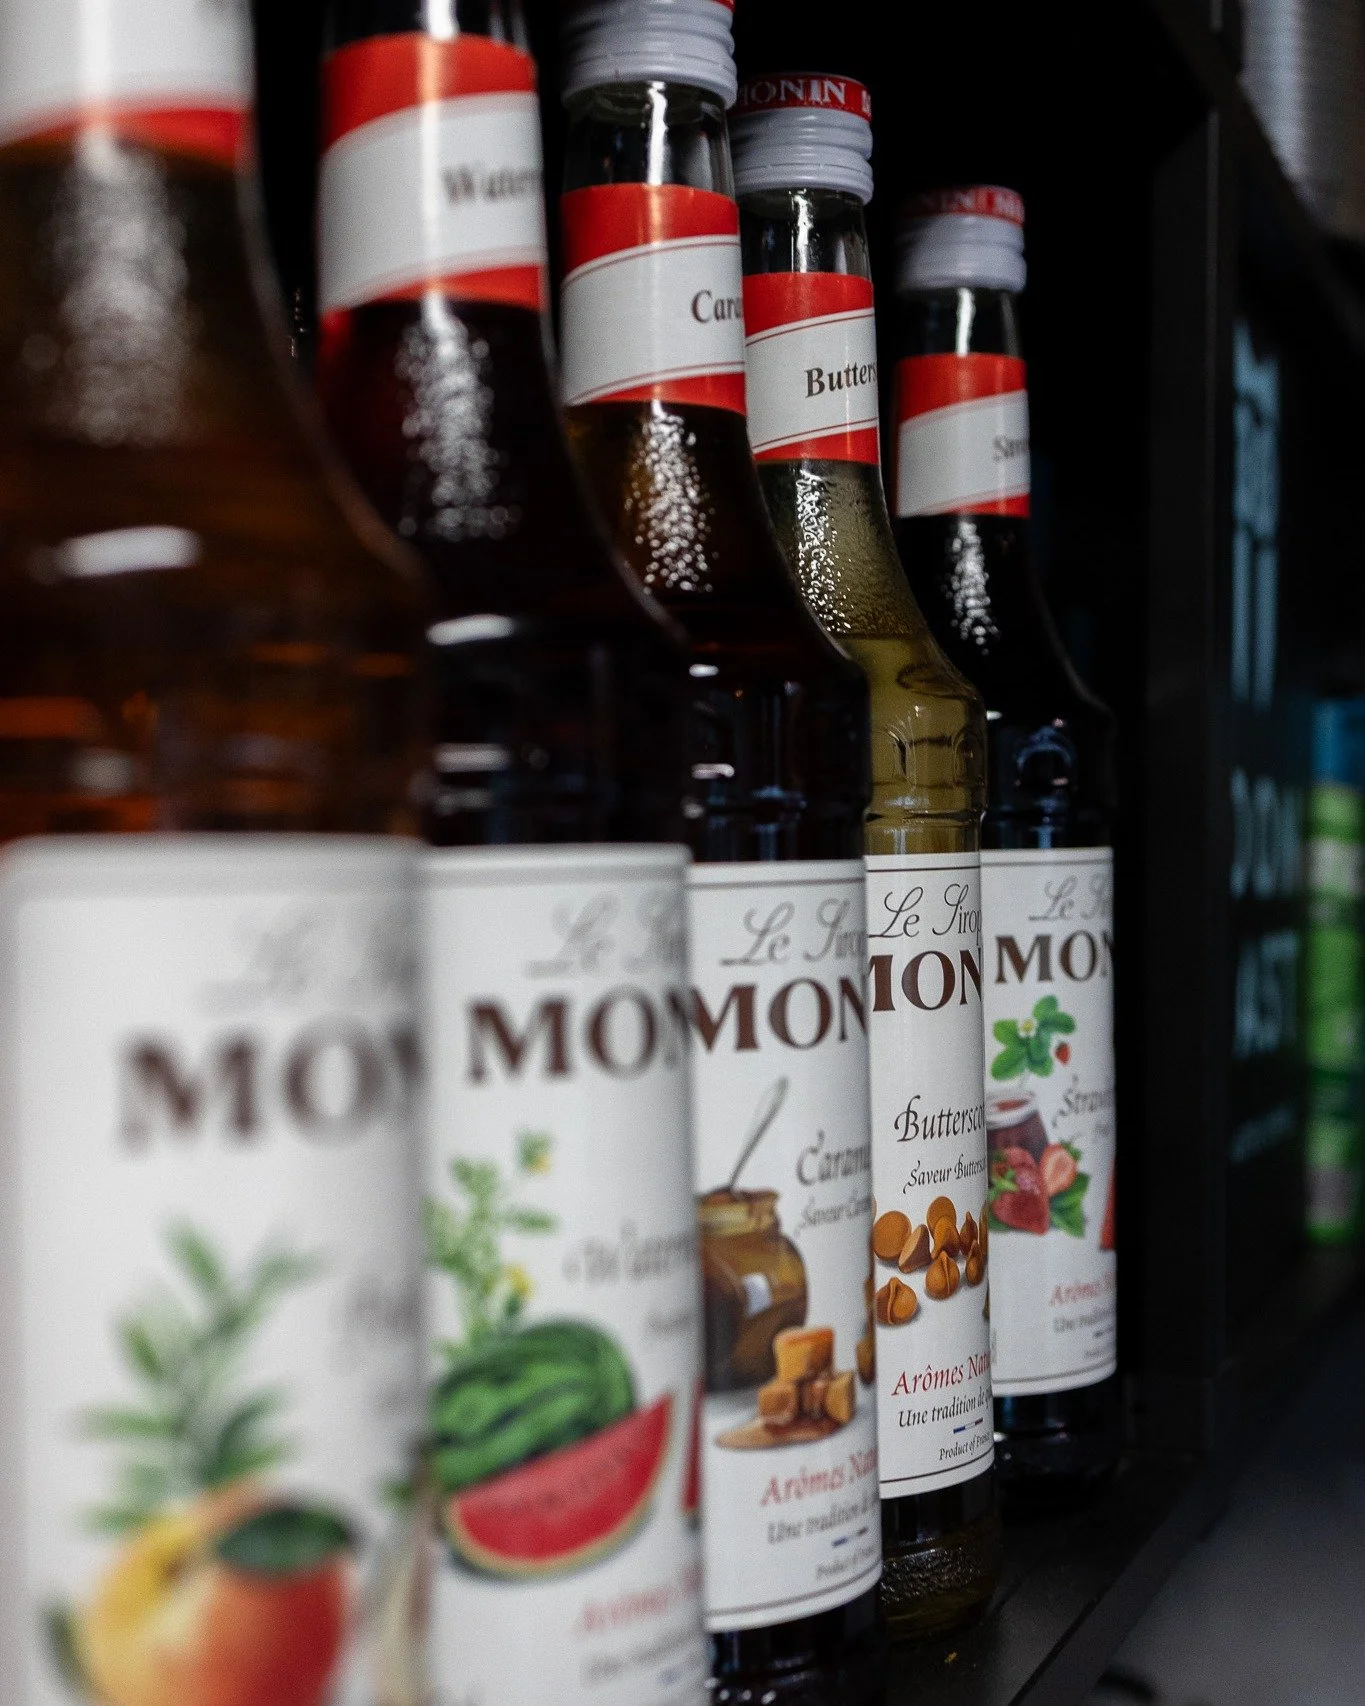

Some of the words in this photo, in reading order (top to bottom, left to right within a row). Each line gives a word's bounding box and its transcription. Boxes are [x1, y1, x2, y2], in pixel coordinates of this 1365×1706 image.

[869, 886, 923, 939] Le
[903, 1160, 951, 1194] Saveur
[891, 1364, 964, 1396] Arômes
[899, 1409, 929, 1428] Une
[931, 1395, 976, 1422] tradition
[939, 1441, 968, 1461] Product
